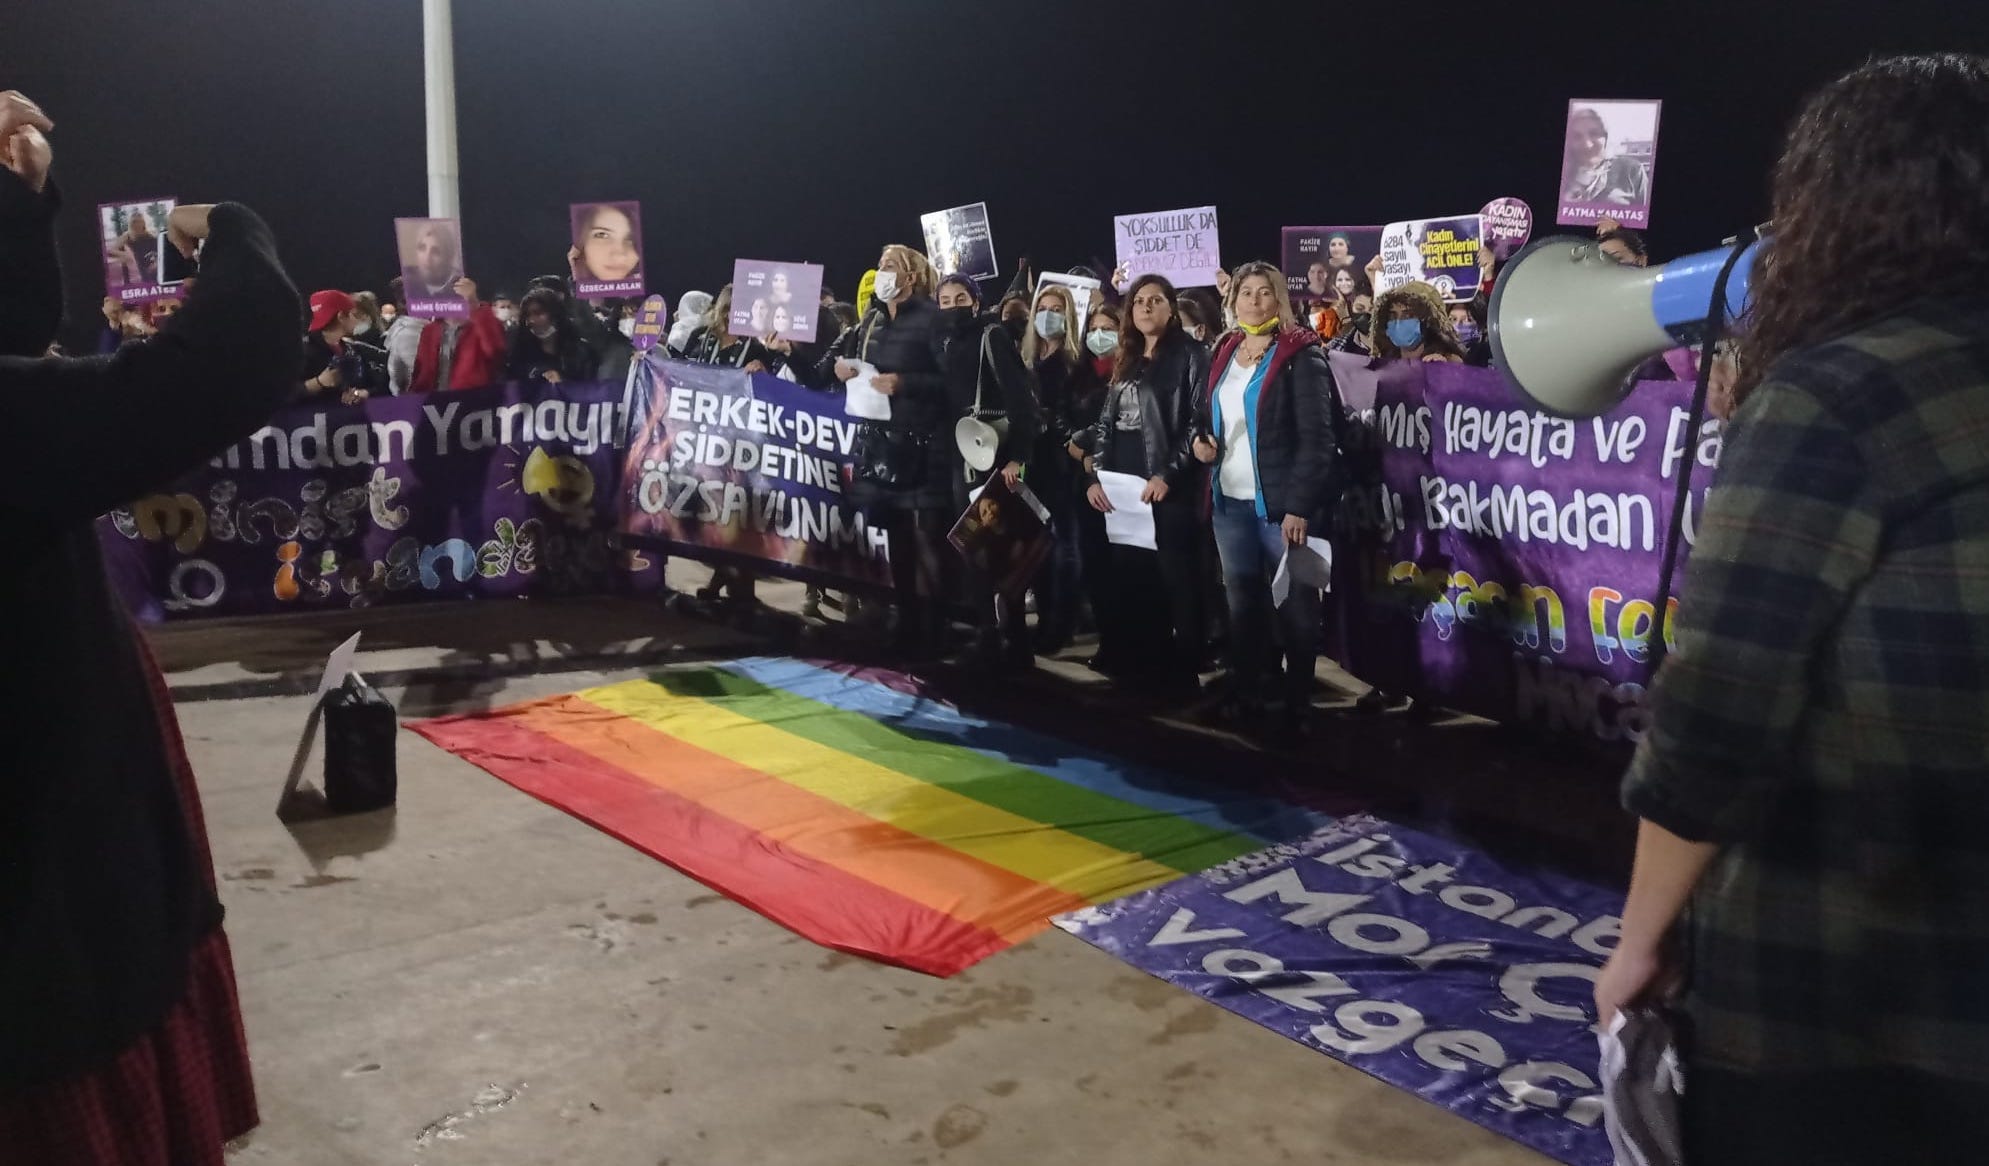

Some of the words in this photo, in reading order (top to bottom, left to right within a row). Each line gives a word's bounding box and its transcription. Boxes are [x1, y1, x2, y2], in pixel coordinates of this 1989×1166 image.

[1199, 212, 1217, 230] DA
[1427, 229, 1453, 242] Kadın
[1488, 202, 1527, 219] KADIN
[1562, 206, 1596, 218] FATMA
[668, 386, 857, 457] ERKEK-DEV
[1444, 400, 1576, 469] Hayata
[1592, 415, 1648, 463] ve
[672, 422, 842, 495] ŞİDDETİNE
[1222, 867, 1492, 970] Mor
[1146, 906, 1603, 1128] Vazgeç
